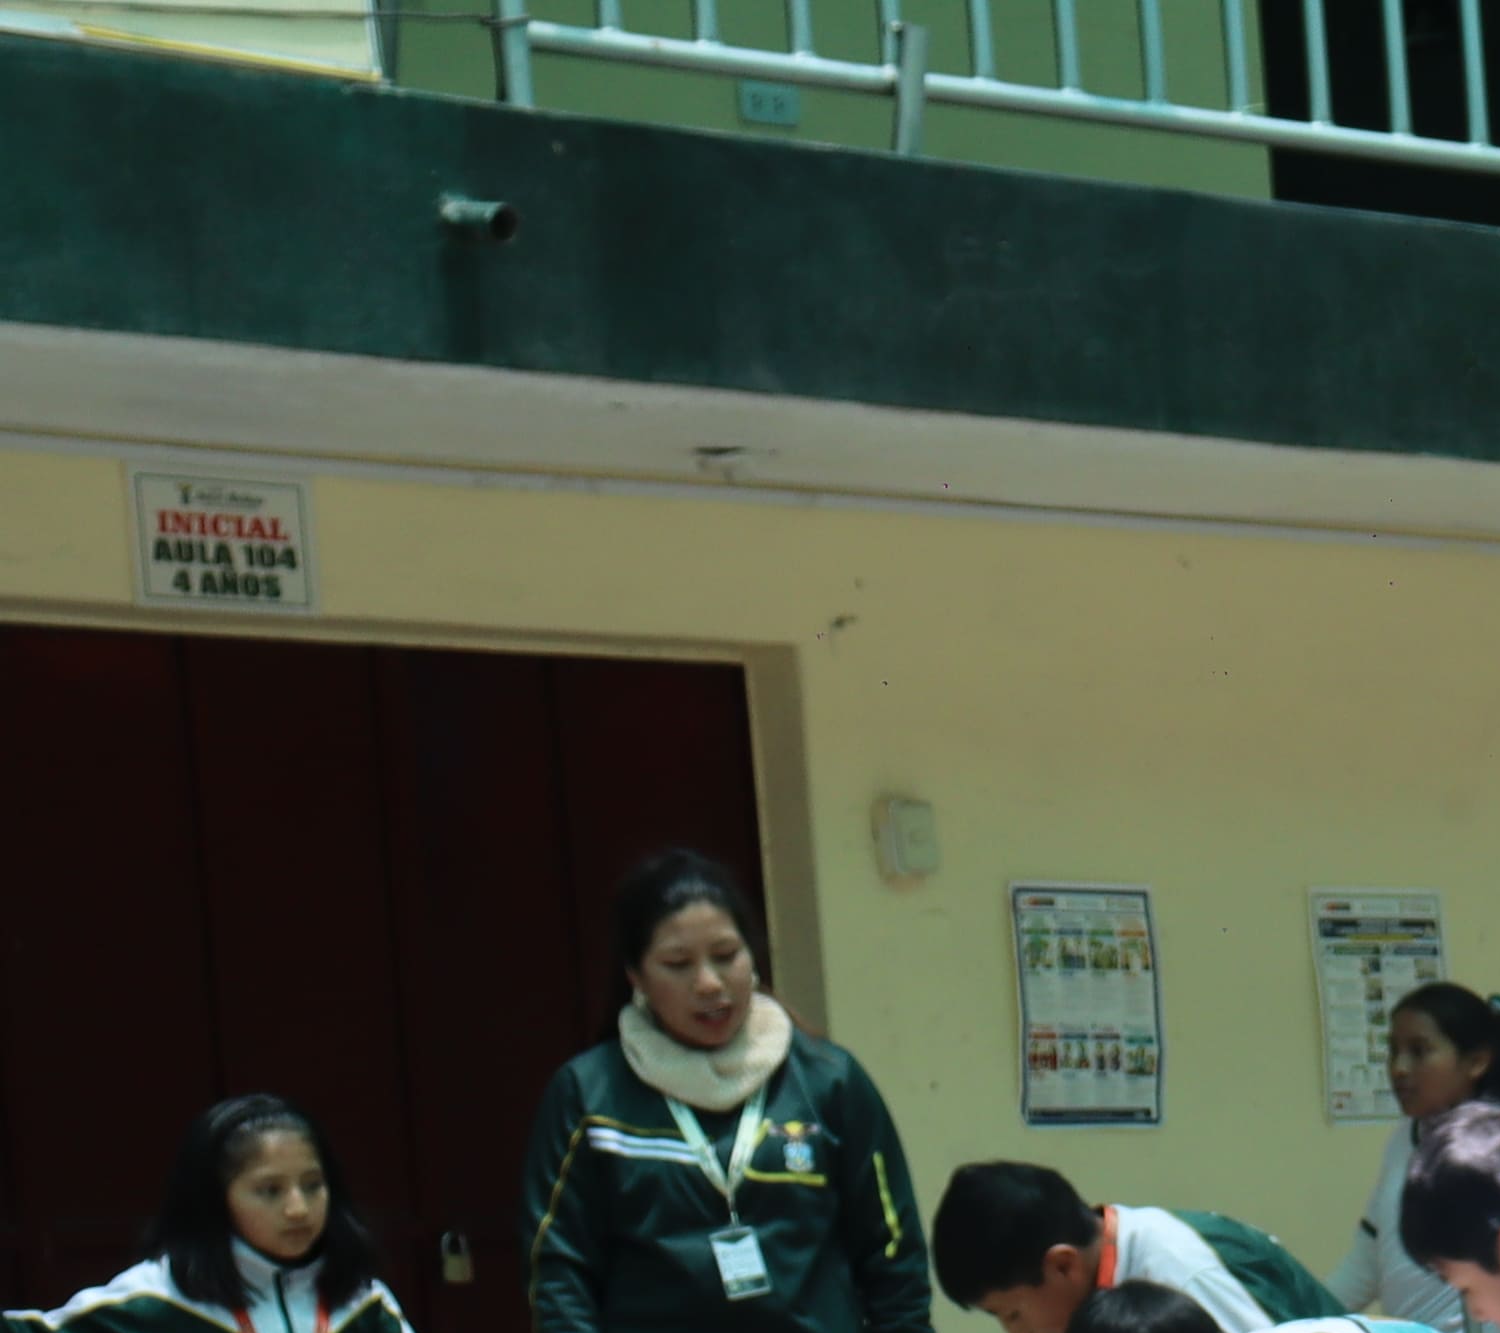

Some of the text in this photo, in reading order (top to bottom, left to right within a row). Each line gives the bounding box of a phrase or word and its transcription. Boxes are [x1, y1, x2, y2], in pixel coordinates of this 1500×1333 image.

[157, 509, 290, 541] INICIAL
[154, 536, 298, 571] AULA 104
[172, 566, 281, 598] 4 AÑOS
